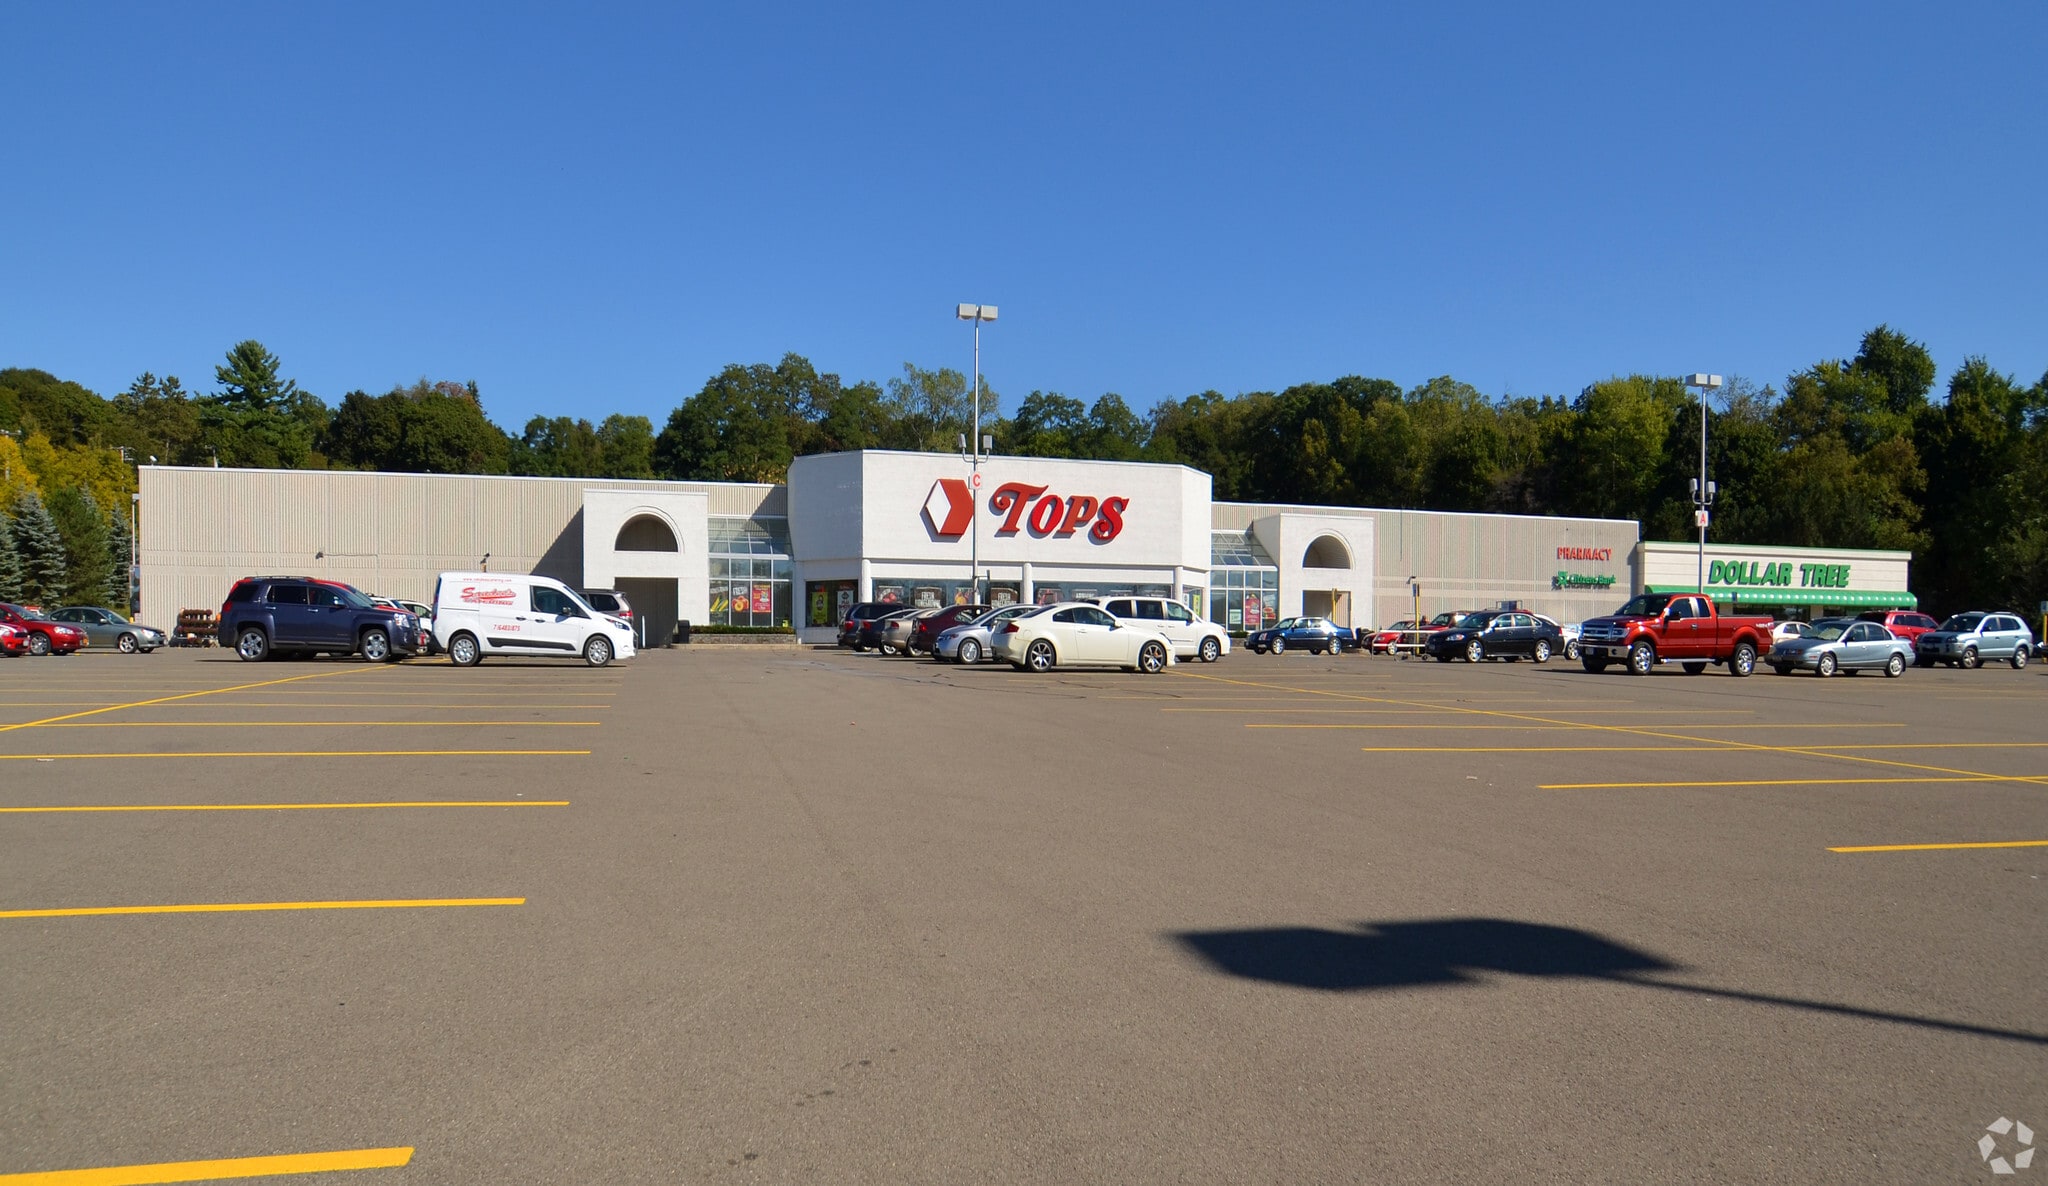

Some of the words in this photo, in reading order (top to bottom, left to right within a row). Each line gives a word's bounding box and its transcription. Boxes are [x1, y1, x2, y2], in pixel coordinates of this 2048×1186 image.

[972, 473, 981, 487] C
[1699, 512, 1707, 524] A
[1556, 546, 1613, 561] PHARMACY
[1568, 573, 1598, 584] Citizens
[1598, 574, 1616, 584] Bank
[1709, 560, 1793, 586] DOLLAR
[1800, 563, 1851, 587] TREE
